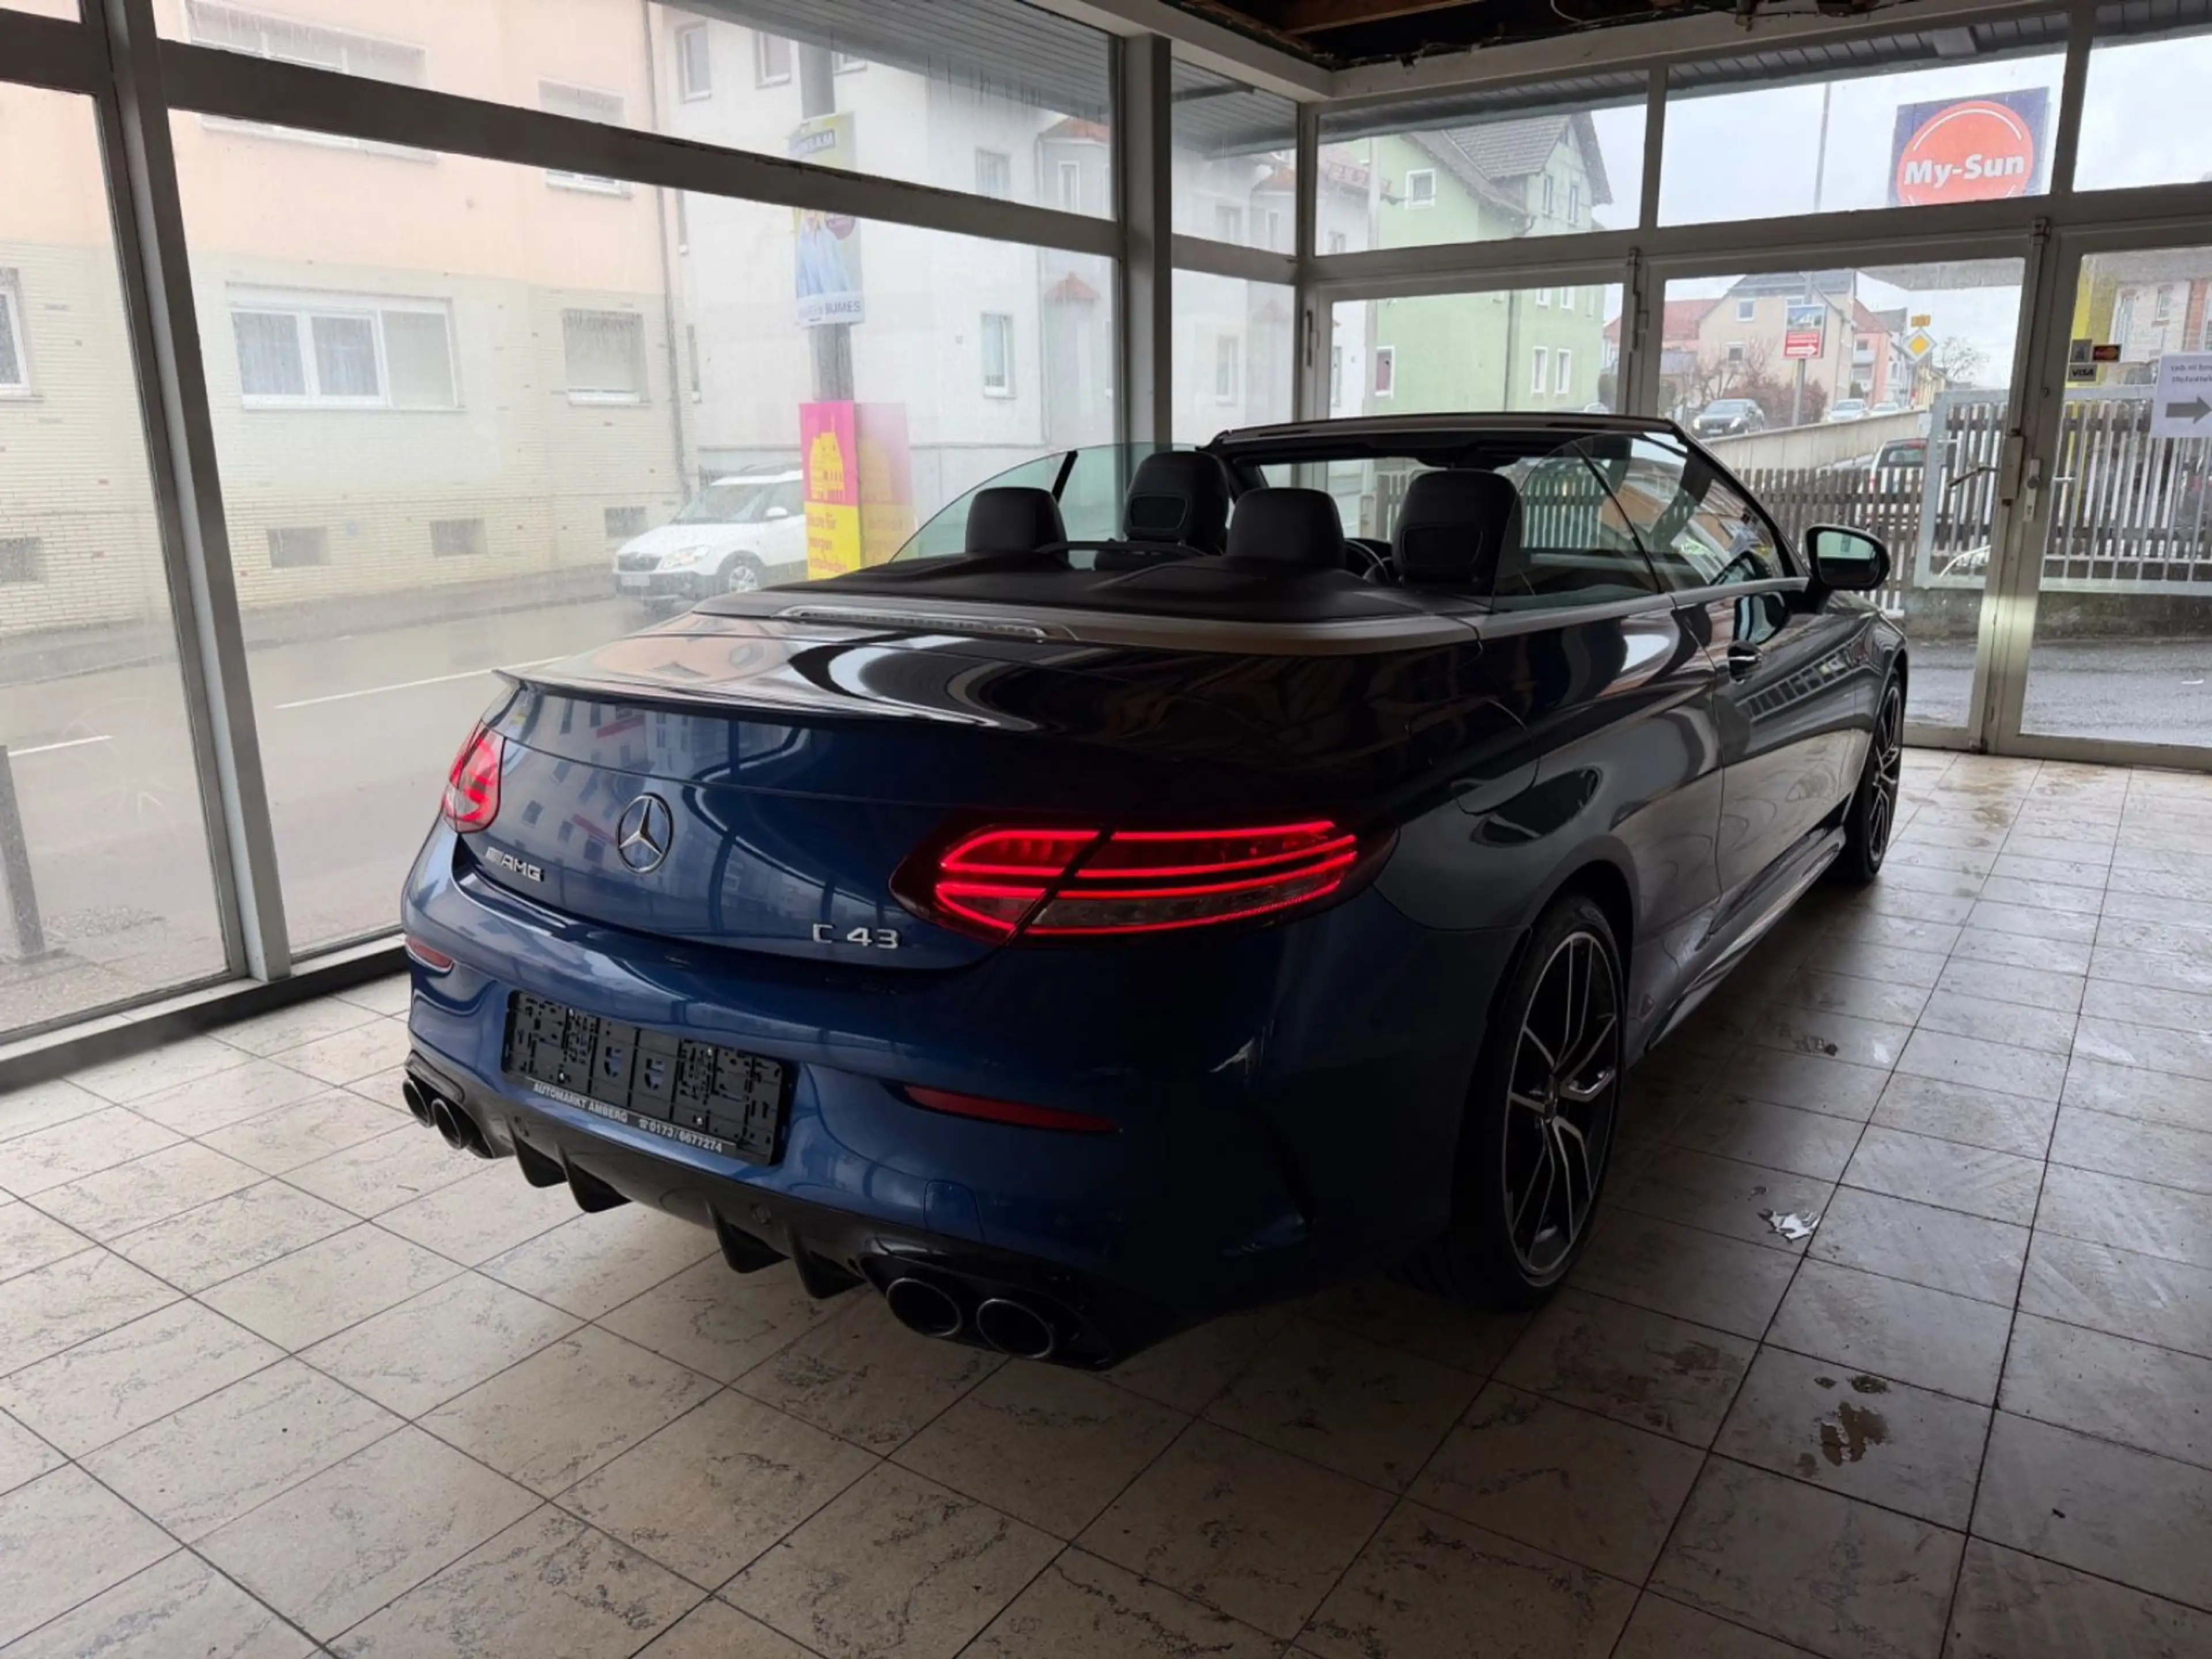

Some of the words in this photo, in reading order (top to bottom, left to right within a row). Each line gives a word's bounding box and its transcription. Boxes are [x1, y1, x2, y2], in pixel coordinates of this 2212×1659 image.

[1903, 153, 2025, 189] My-Sun
[2072, 368, 2094, 377] VISA
[499, 853, 542, 882] AMG
[813, 923, 834, 944] C
[846, 927, 899, 949] 43
